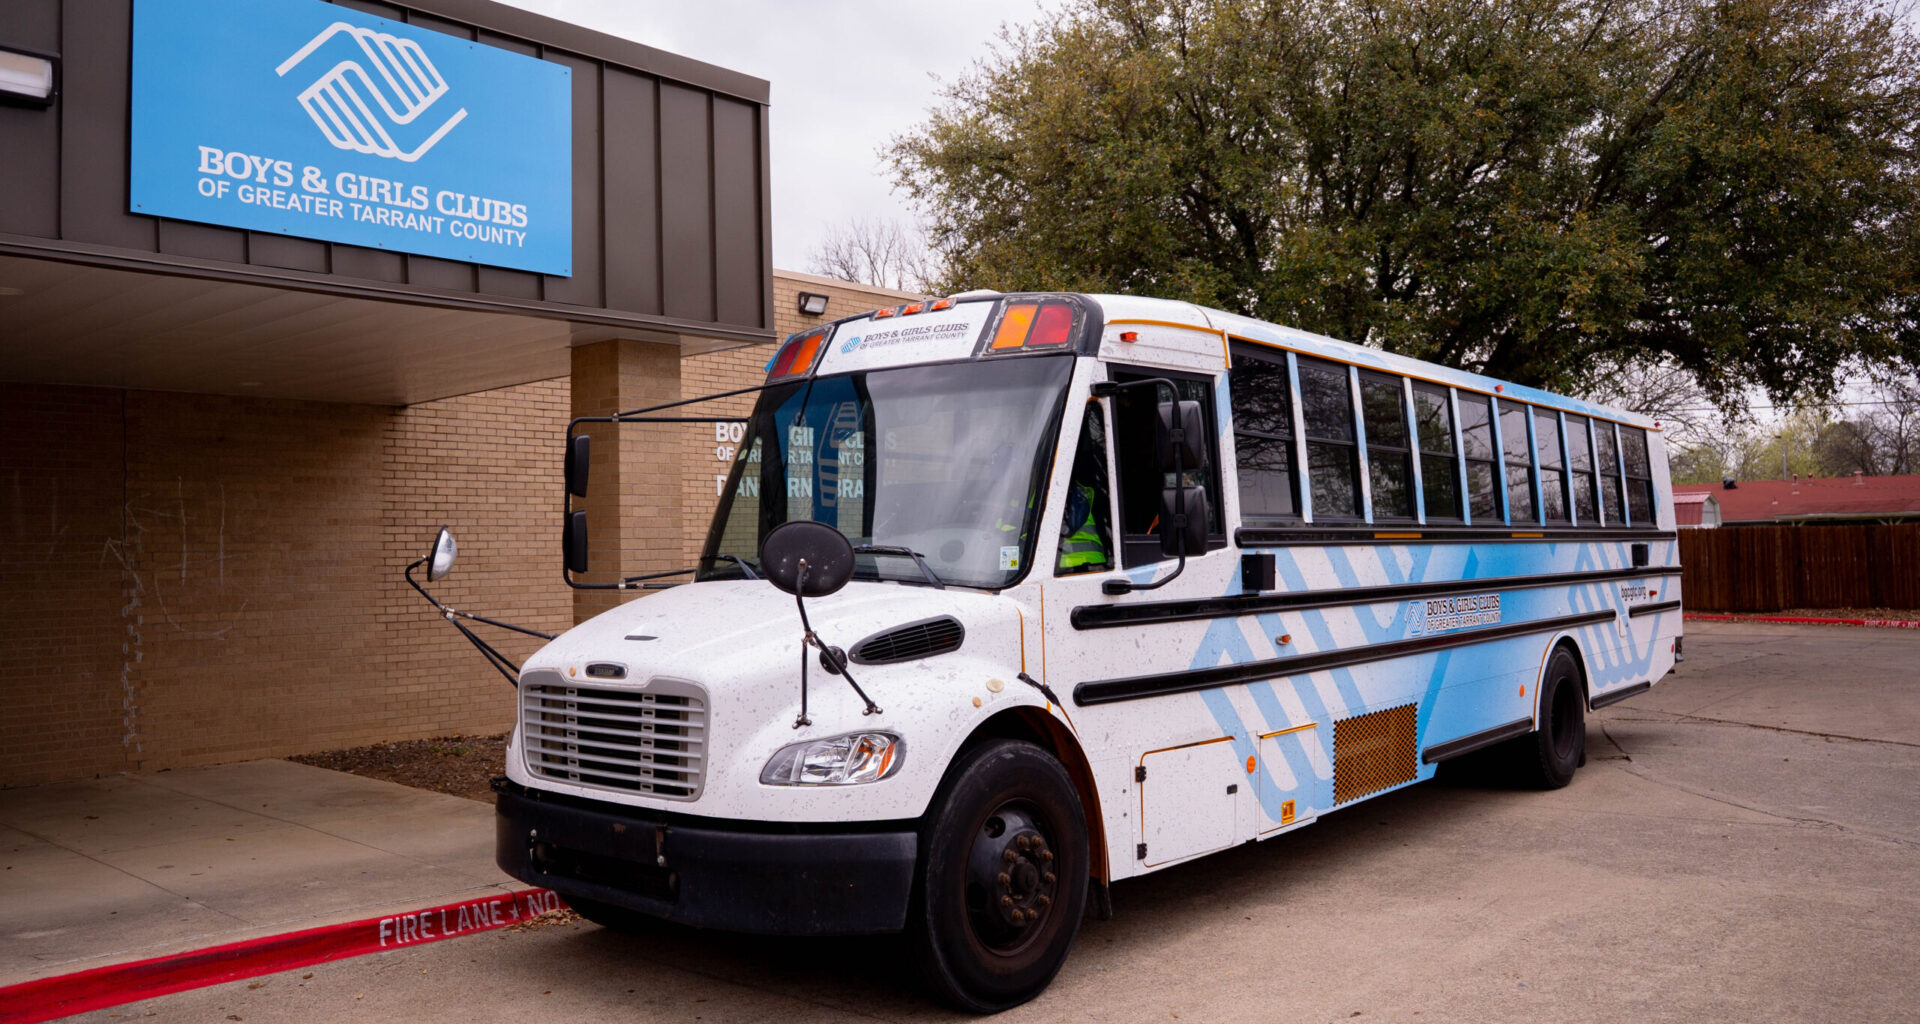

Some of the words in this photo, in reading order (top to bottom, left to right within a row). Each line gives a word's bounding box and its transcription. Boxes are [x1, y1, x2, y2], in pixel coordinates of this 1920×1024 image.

[198, 145, 294, 187] BOYS
[301, 166, 330, 195] &
[335, 172, 429, 211] GIRLS
[436, 190, 528, 228] CLUBS
[198, 177, 231, 199] OF
[237, 184, 344, 219] GREATER
[350, 202, 445, 235] TARRANT
[450, 220, 527, 248] COUNTY
[864, 331, 892, 343] BOYS
[890, 329, 899, 338] &
[900, 325, 933, 337] GIRLS
[933, 322, 969, 334] CLUBS
[869, 337, 901, 348] GREATER
[902, 333, 934, 342] TARRANT
[935, 332, 967, 340] COUNTY
[716, 446, 735, 461] OF
[1427, 600, 1448, 617] BOYS
[1449, 599, 1456, 614] &
[1456, 597, 1478, 612] GIRLS
[1479, 594, 1500, 610] CLUBS
[1427, 619, 1435, 631] OF
[1435, 615, 1459, 630] GREATER
[1460, 613, 1482, 628] TARRANT
[1483, 611, 1501, 625] COUNTY
[379, 911, 436, 947] FIRE
[440, 899, 506, 936] LANE
[527, 890, 561, 917] NO
